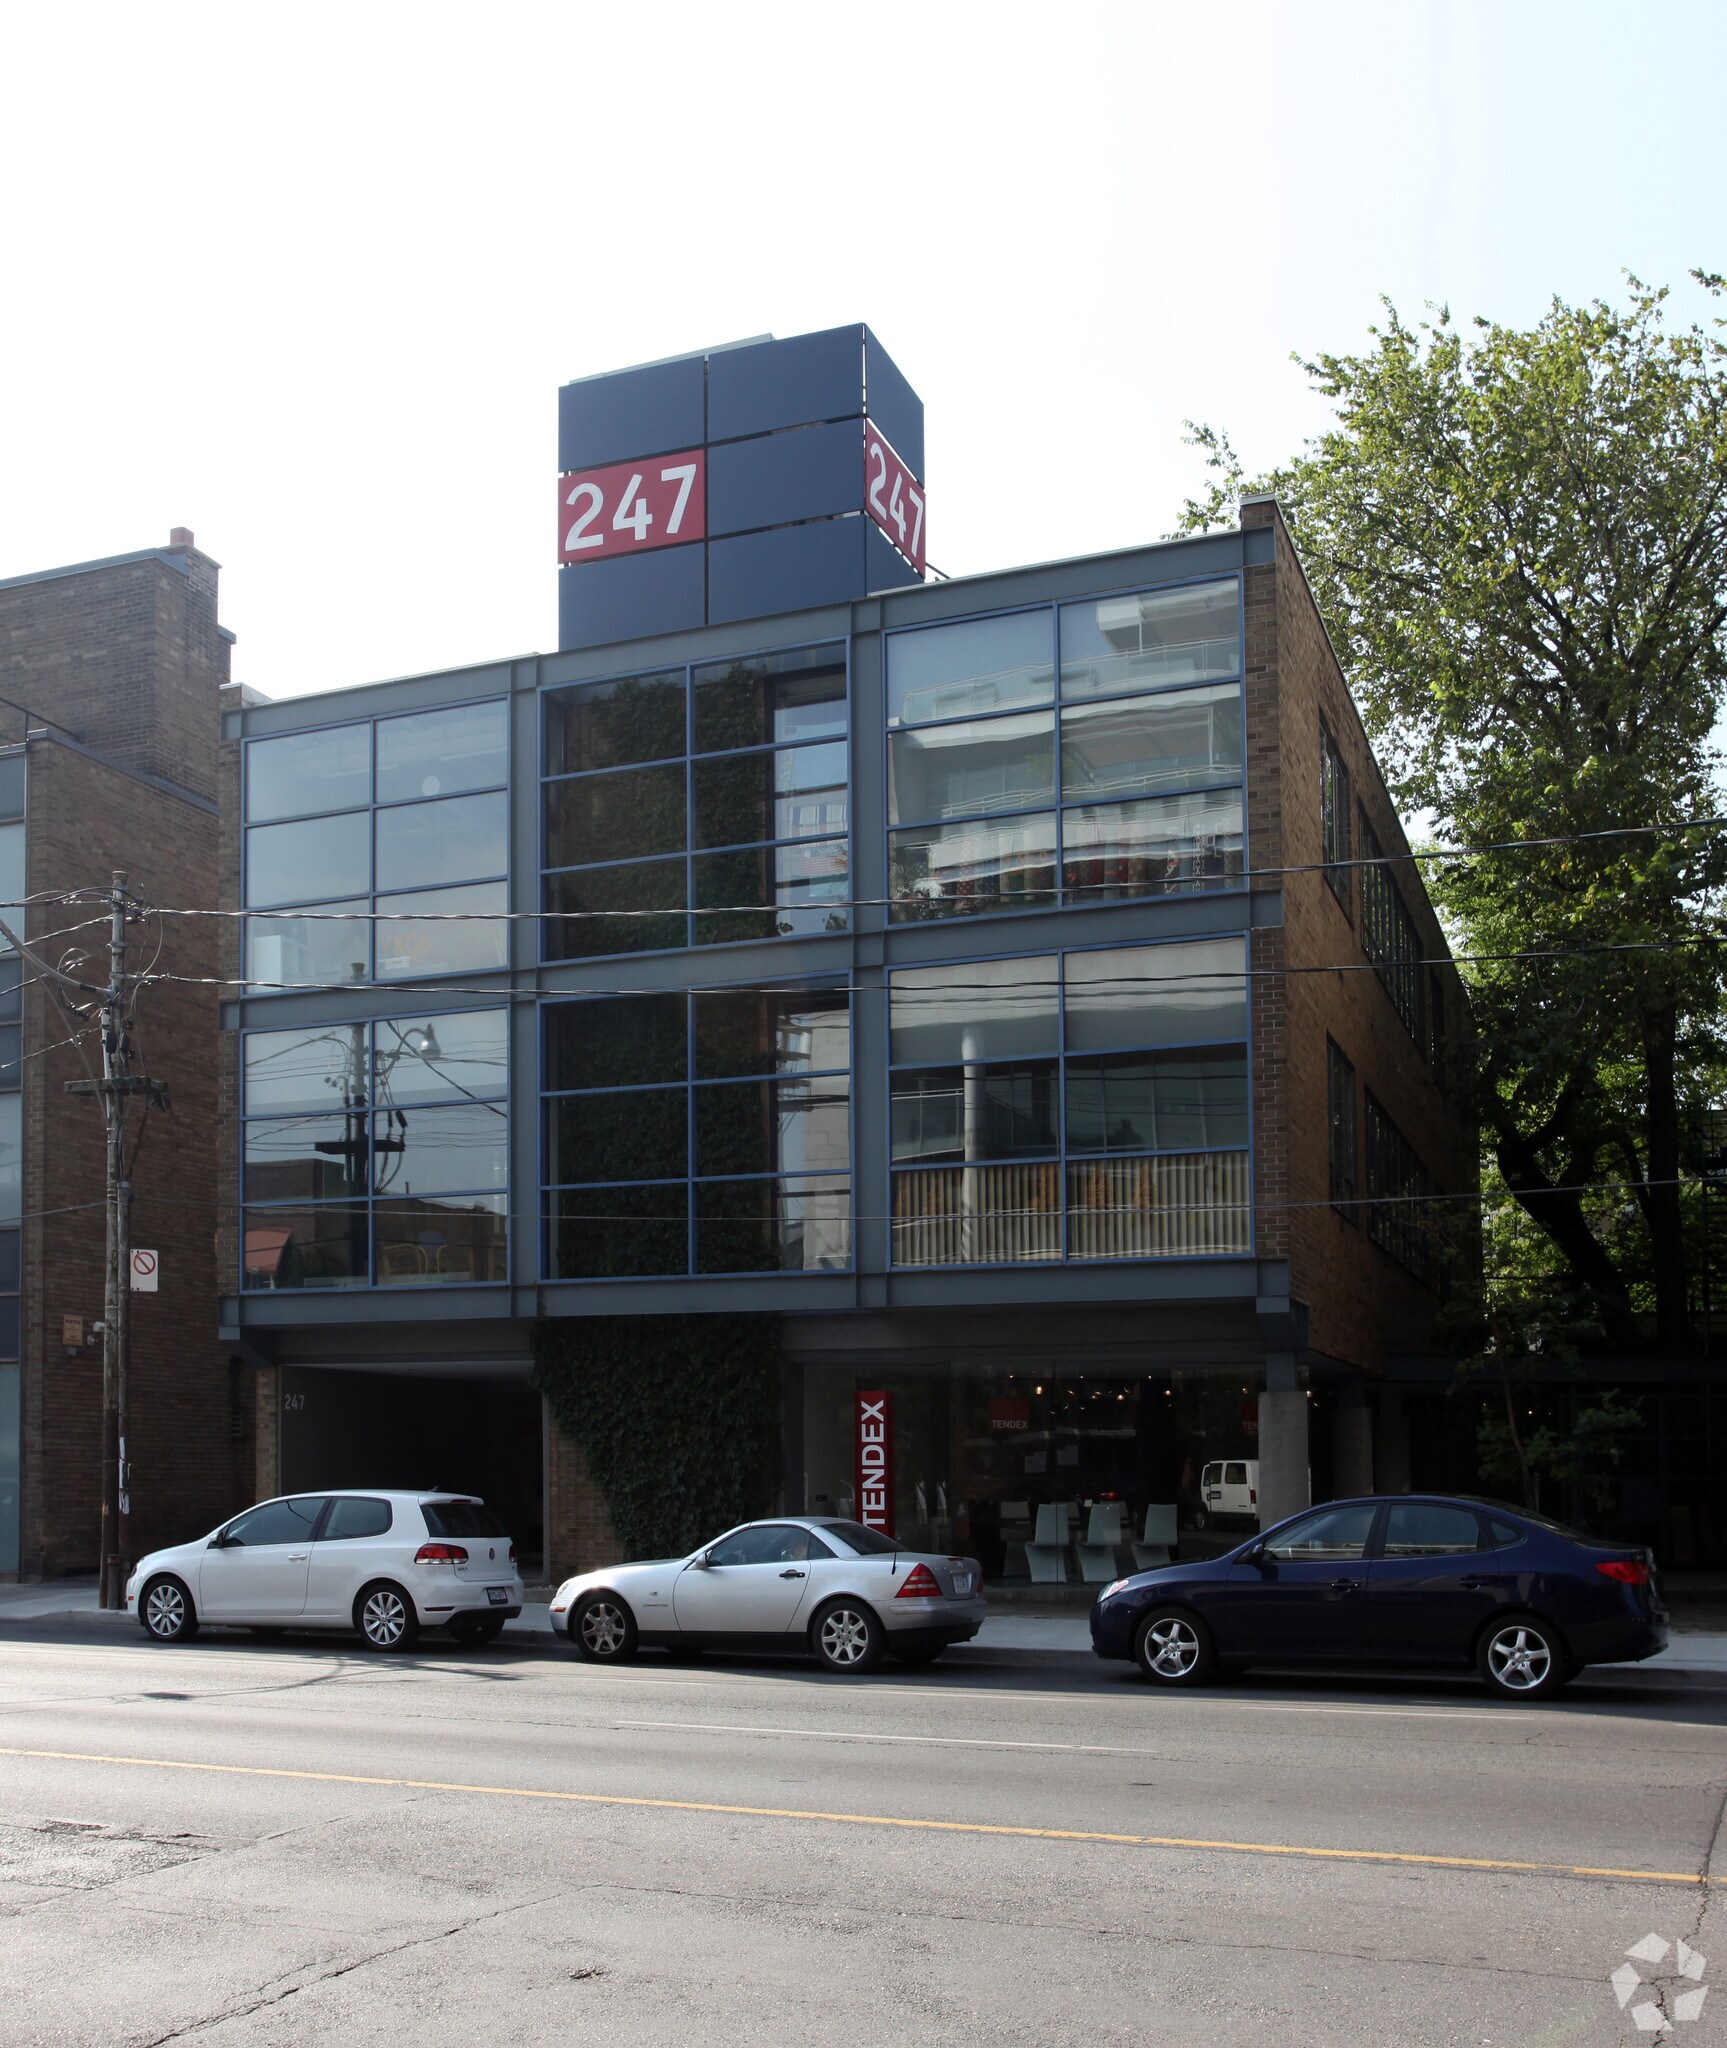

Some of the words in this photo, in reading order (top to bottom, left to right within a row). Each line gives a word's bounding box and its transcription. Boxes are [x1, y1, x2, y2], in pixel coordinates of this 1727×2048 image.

[565, 463, 696, 551] 247
[870, 442, 924, 557] 247
[285, 1393, 304, 1410] 247
[991, 1420, 1028, 1429] TENDEX
[1241, 1421, 1258, 1430] TEN
[861, 1399, 886, 1527] TENDEX
